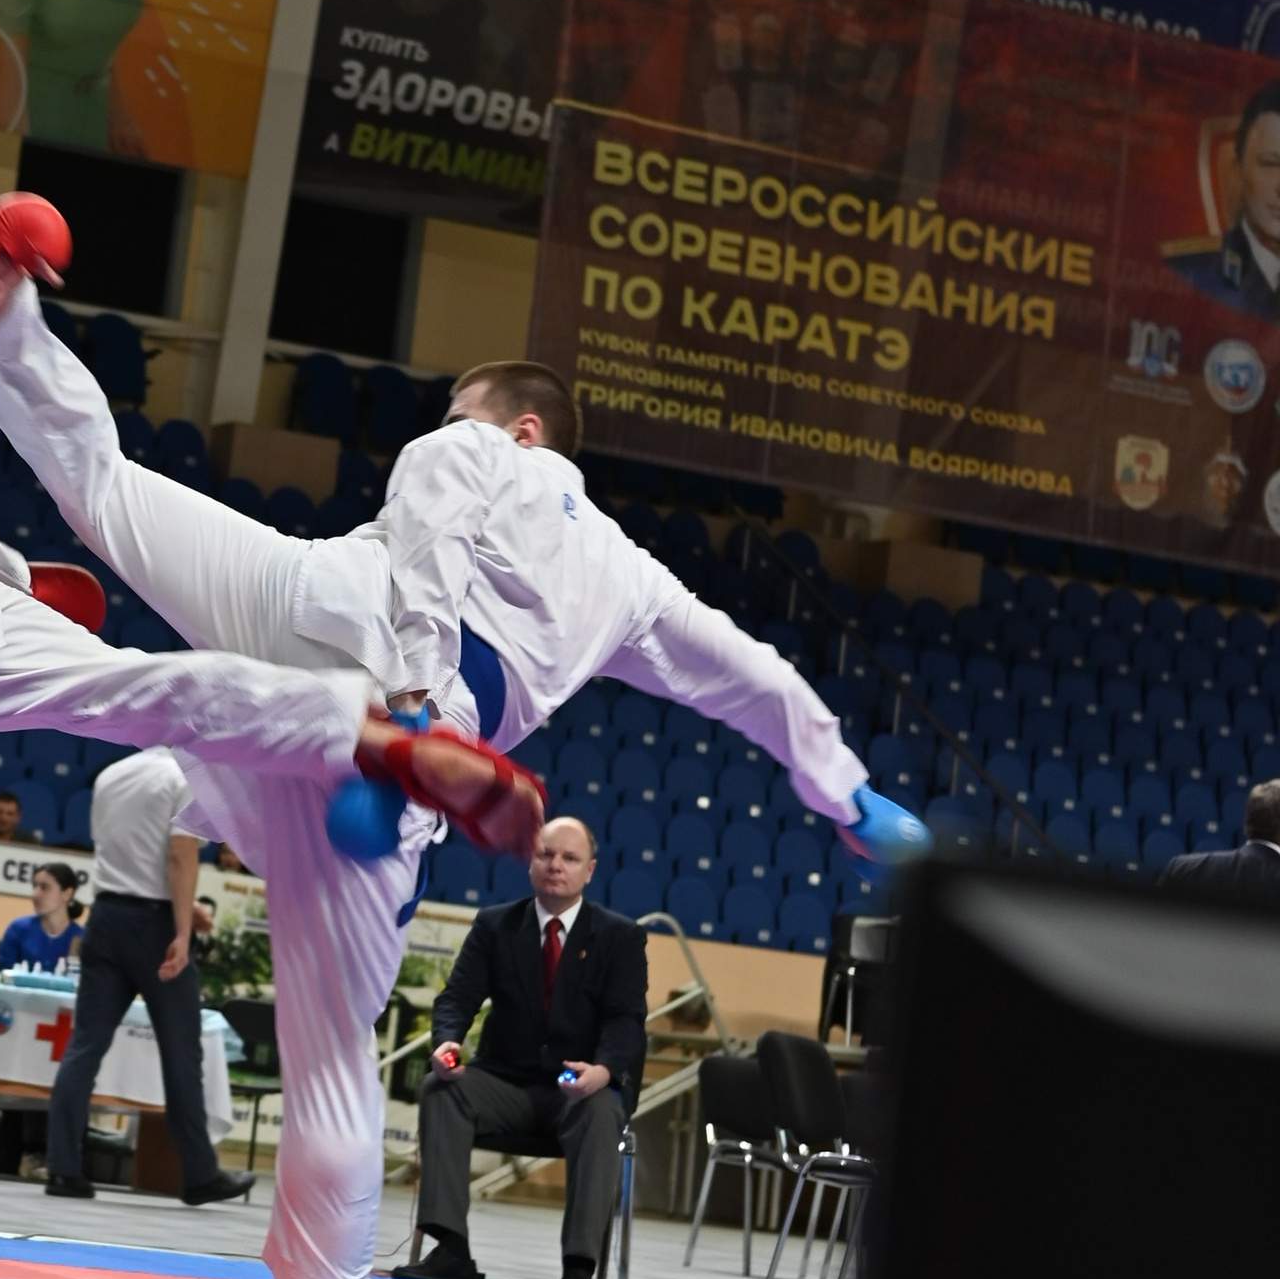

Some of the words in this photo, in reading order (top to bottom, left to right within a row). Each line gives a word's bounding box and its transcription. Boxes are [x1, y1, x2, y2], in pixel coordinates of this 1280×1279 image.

[339, 26, 430, 62] КУПИТЬ
[348, 122, 546, 195] ВИТАМИН
[593, 139, 1096, 286] ВСЕРОССИЙСКИЕ
[582, 265, 664, 320] ПО
[680, 285, 912, 372] КАРАТЭ
[588, 204, 1057, 340] СОРЕВНОВАНИЯ
[576, 354, 726, 400] ПОЛКОВНИКА
[579, 327, 650, 360] КУБОК
[656, 345, 749, 378] ПАМЯТИ
[753, 363, 822, 395] ГЕРОЯ
[826, 378, 965, 422] СОВЕТСКОГО
[970, 405, 1048, 437] СОЮЗА
[573, 380, 722, 430] ГРИГОРИЯ
[729, 411, 900, 466] ИВАНОВИЧА
[909, 446, 1073, 498] БОЯРИНОВА
